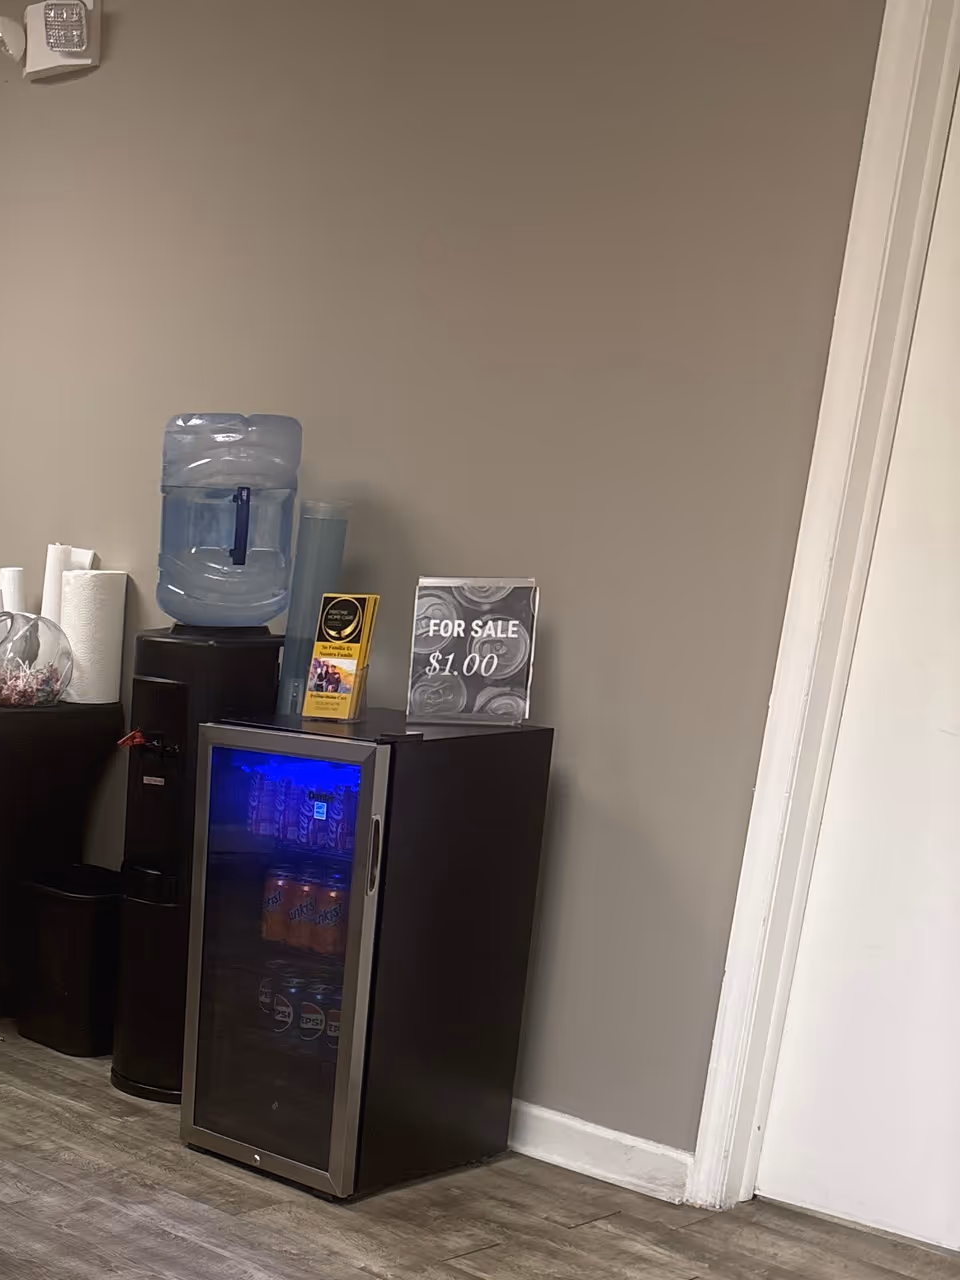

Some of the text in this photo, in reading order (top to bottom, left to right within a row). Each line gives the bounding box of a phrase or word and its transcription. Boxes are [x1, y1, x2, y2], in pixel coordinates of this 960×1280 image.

[428, 619, 520, 638] FOR SALE
[425, 650, 498, 679] $1.00
